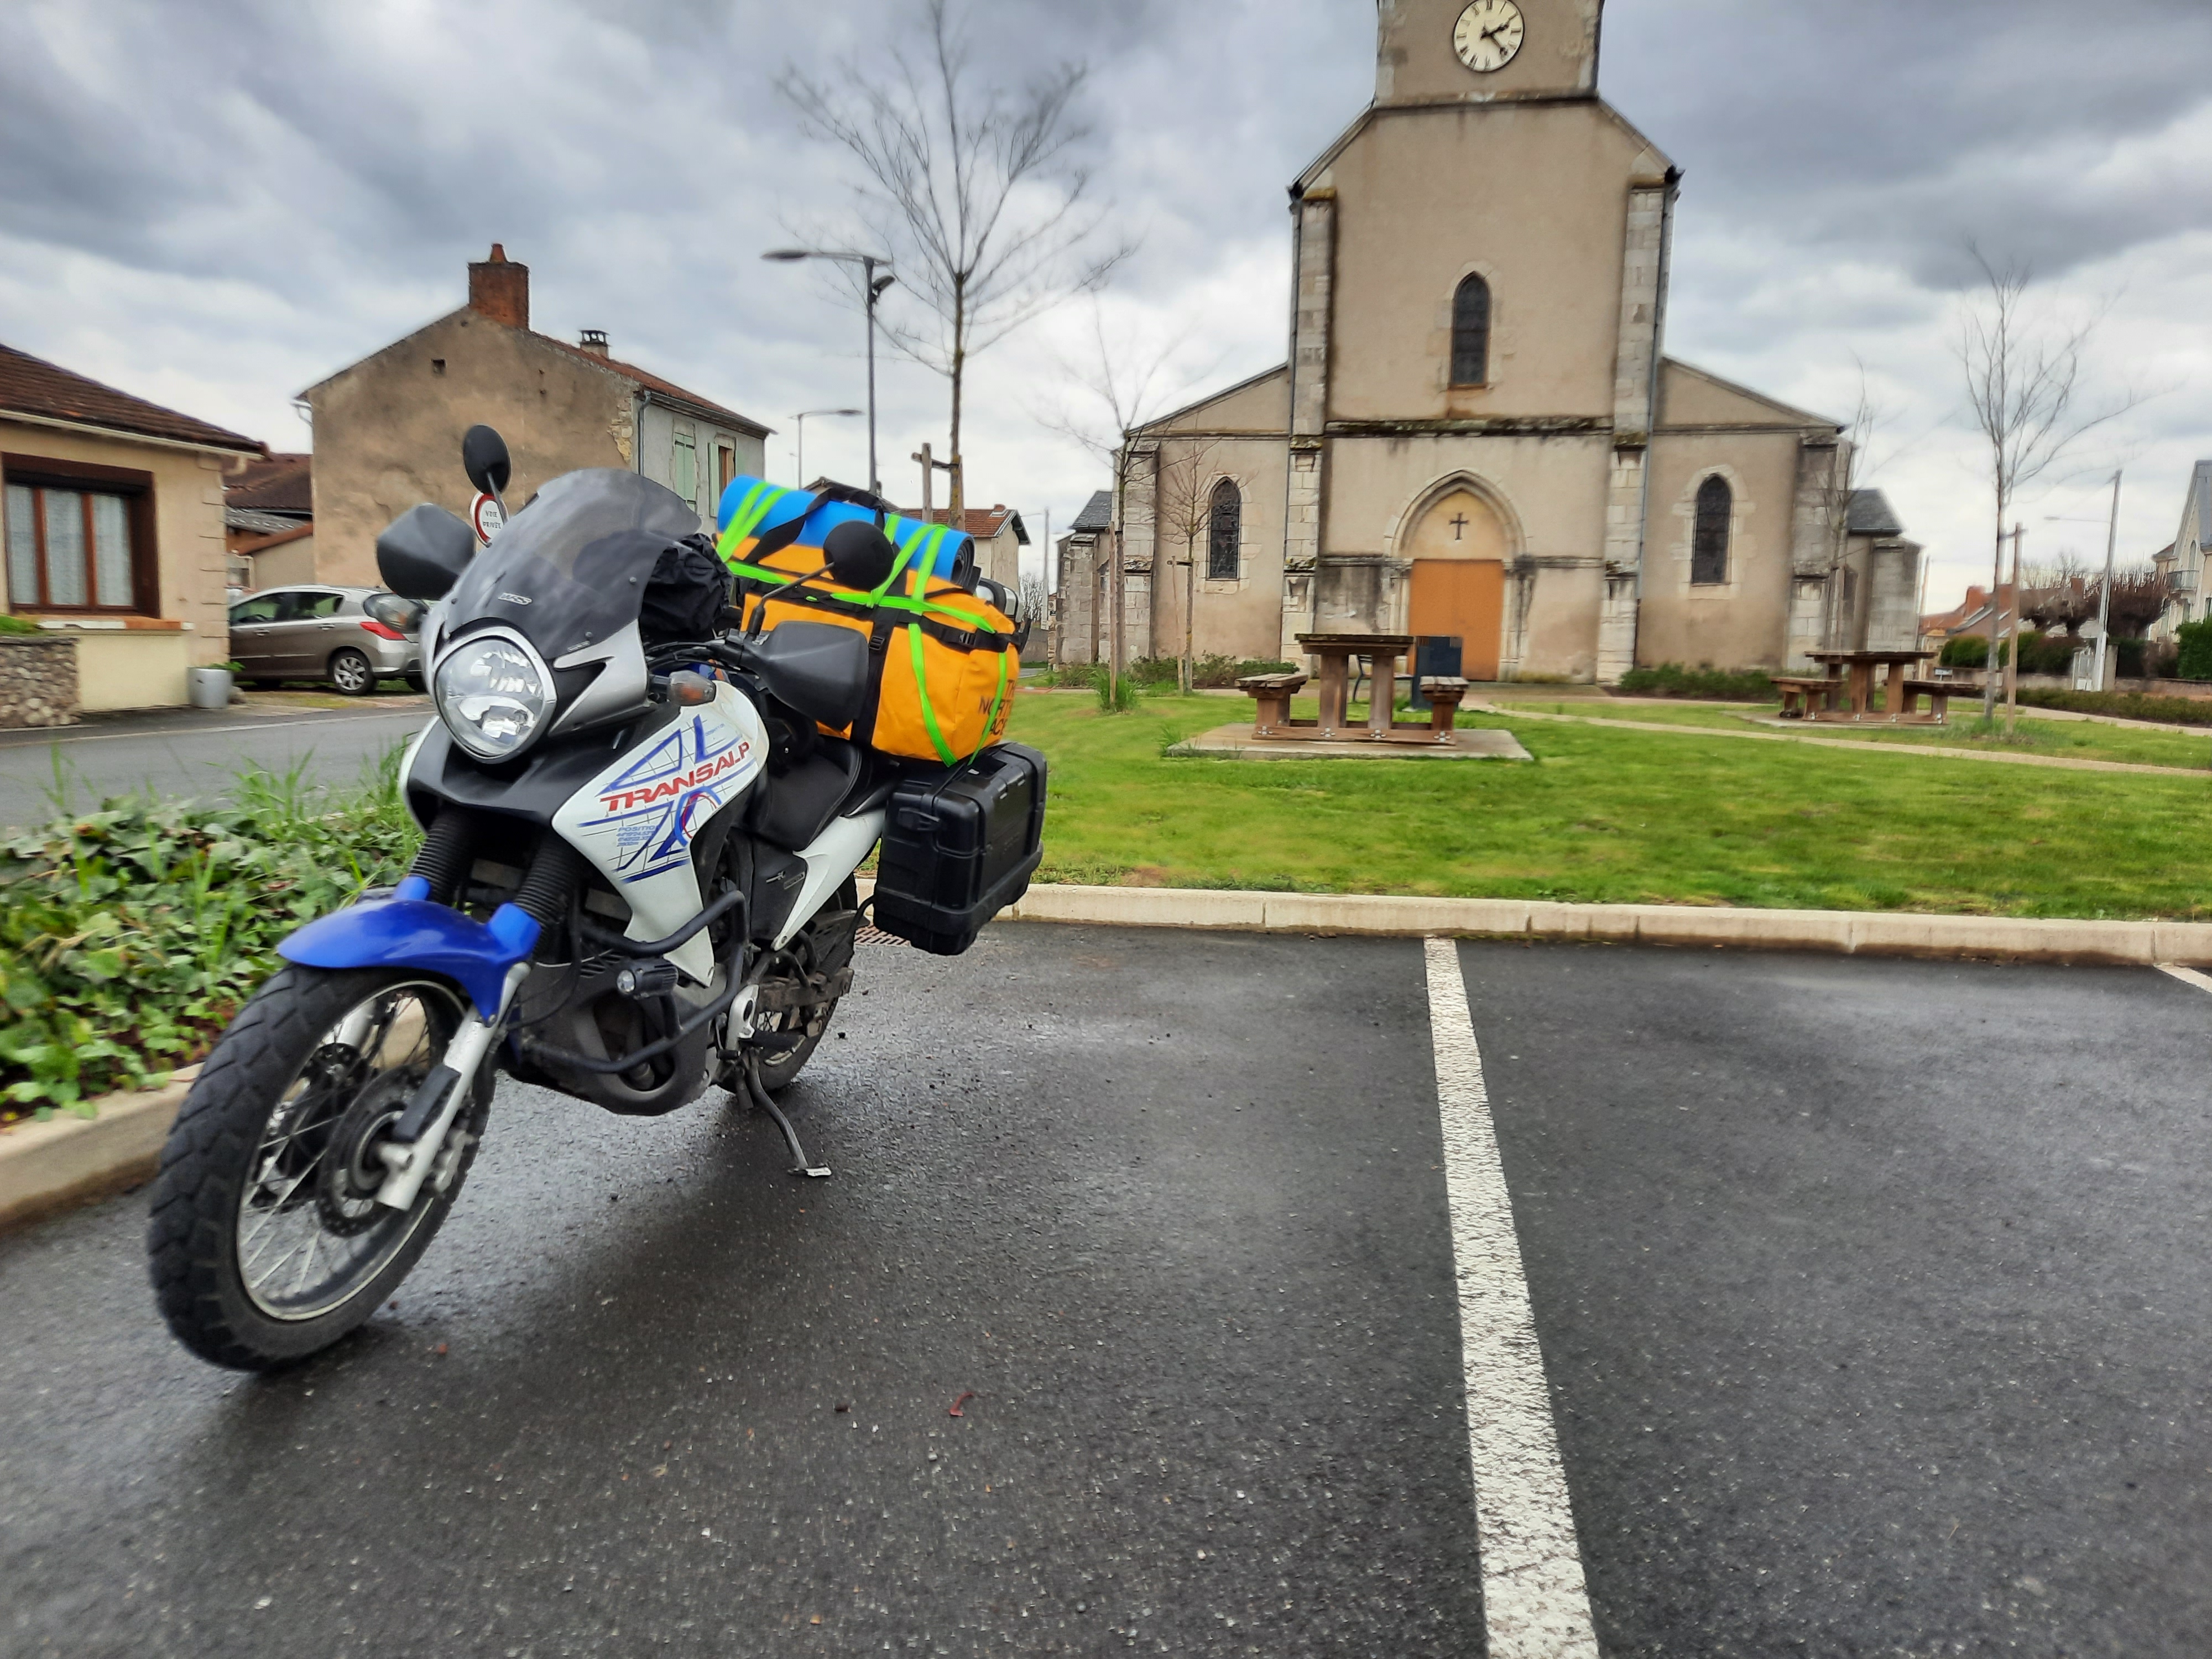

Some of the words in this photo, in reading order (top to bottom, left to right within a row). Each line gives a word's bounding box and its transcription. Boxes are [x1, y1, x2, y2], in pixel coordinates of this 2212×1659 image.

[1005, 680, 1015, 698] TH
[978, 696, 1013, 717] NORT
[600, 741, 750, 811] TRANSALP
